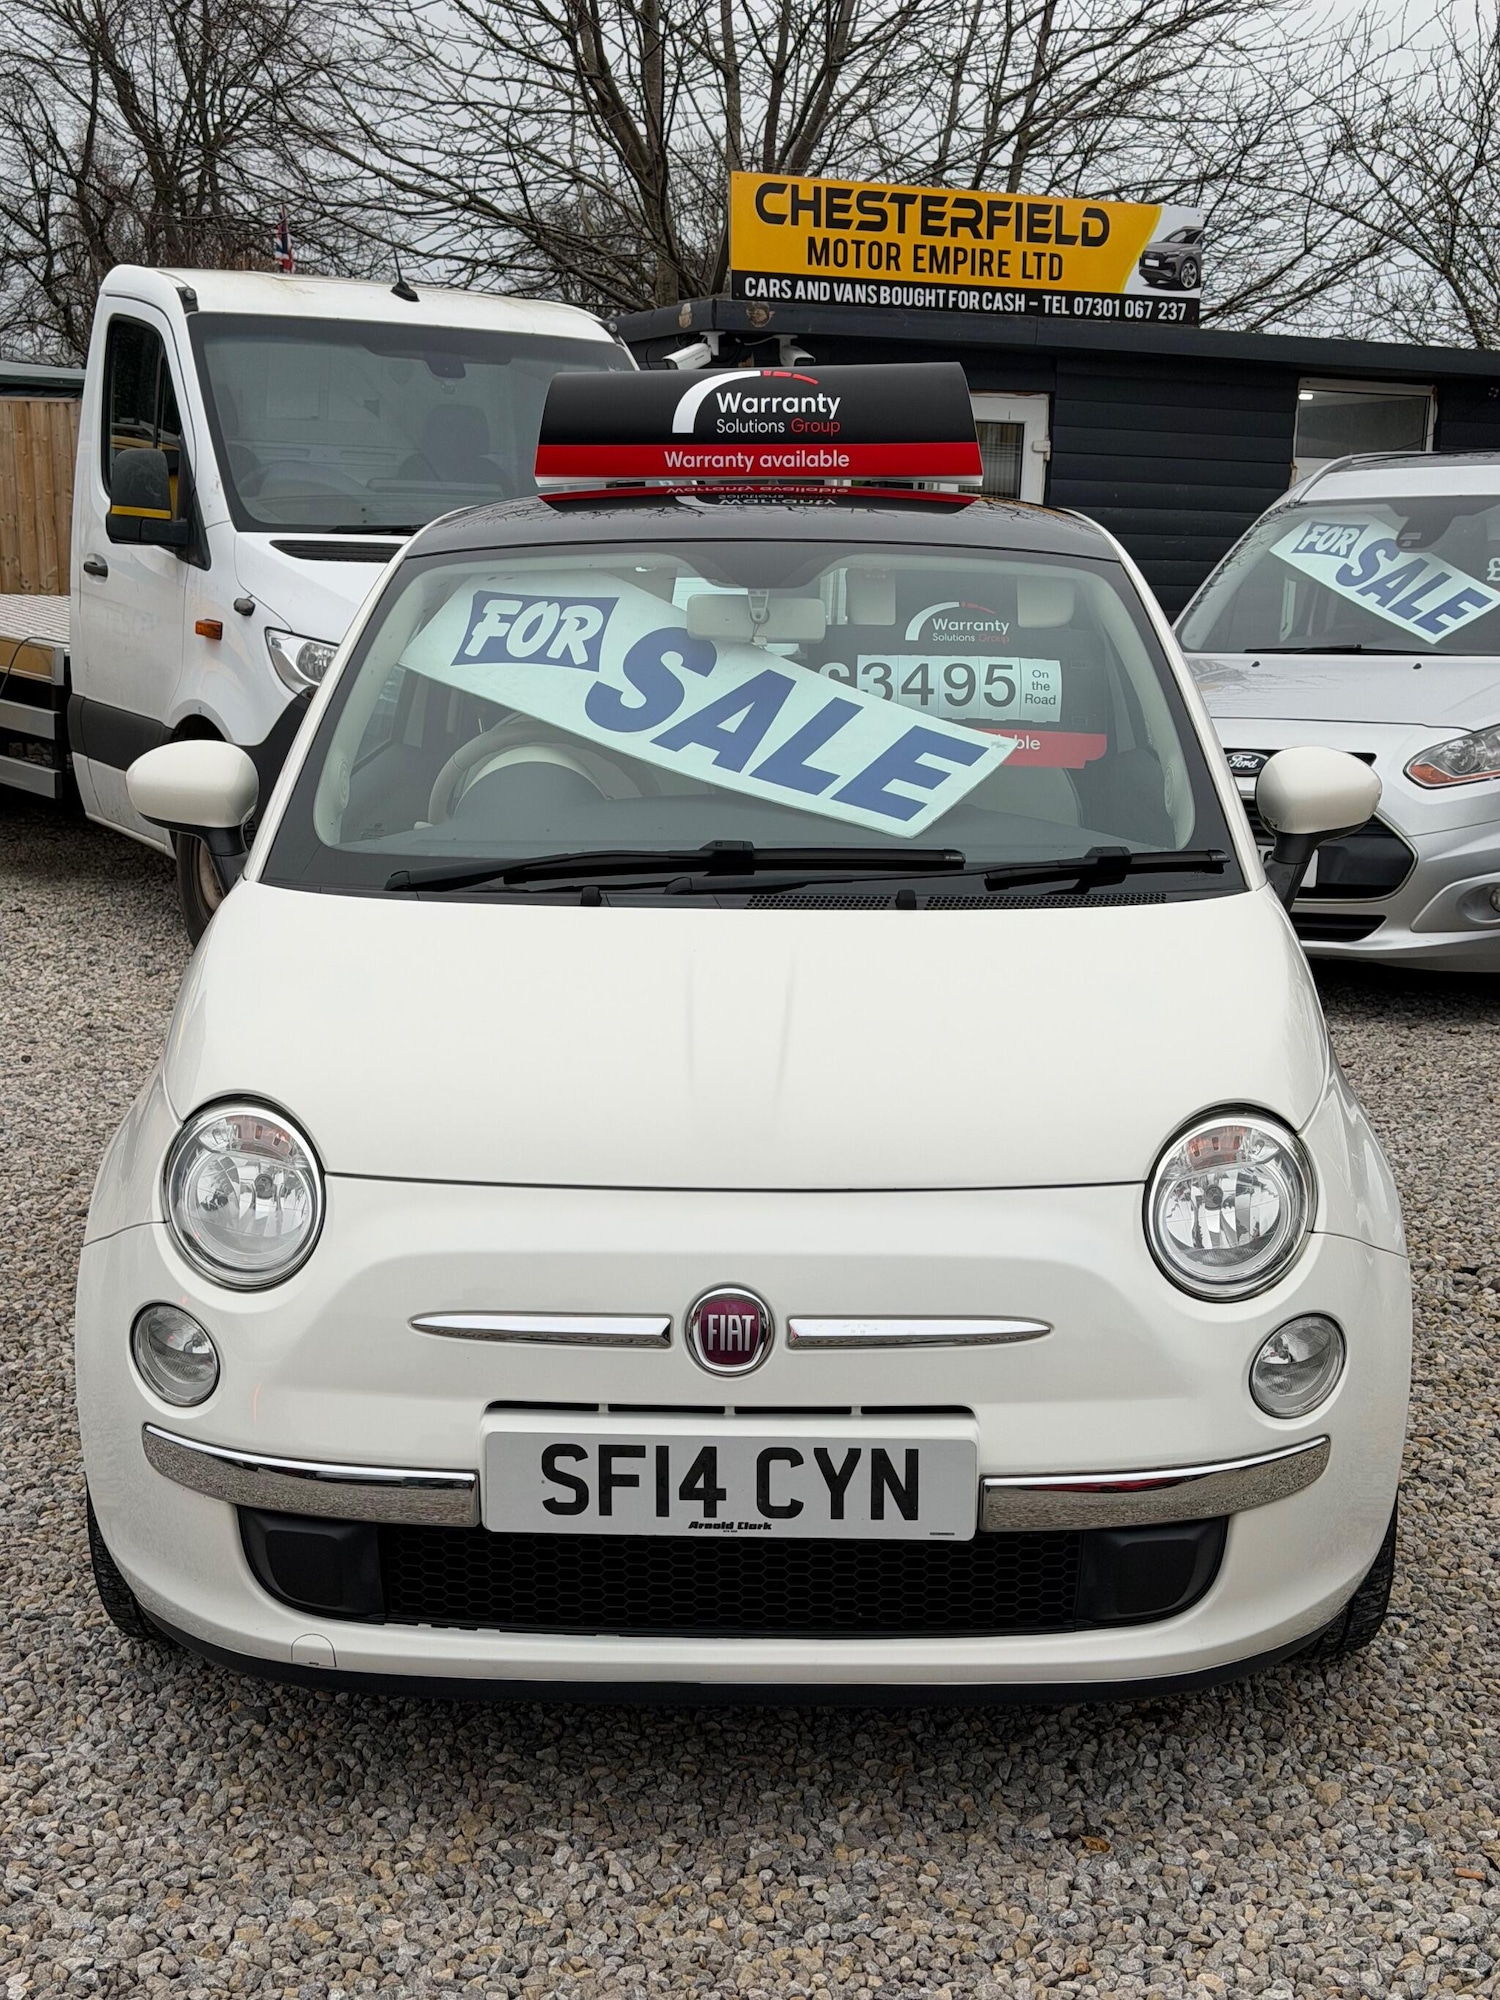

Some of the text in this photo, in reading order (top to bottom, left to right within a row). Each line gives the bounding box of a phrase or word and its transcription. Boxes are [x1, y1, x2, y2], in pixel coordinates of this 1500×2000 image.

[755, 181, 1111, 248] CHESTERFIELD
[807, 236, 1063, 281] MOTOR EMPIRE LTD
[744, 277, 791, 299] CARS
[795, 280, 830, 301] AND
[833, 282, 878, 305] VANS
[880, 284, 944, 309] BOUGHT
[946, 288, 980, 310] FOR
[982, 290, 1026, 313] CASH
[1042, 294, 1070, 316] TEL
[1073, 295, 1120, 318] 07301
[1124, 299, 1154, 319] 067
[1157, 301, 1187, 321] 237
[716, 391, 841, 420] Warranty
[716, 418, 841, 437] Solutions Group
[664, 450, 850, 473] Warranty available
[1298, 525, 1361, 557] FOR
[1335, 538, 1494, 635] SALE
[471, 598, 606, 666] FOR
[932, 617, 1010, 635] Warranty
[932, 632, 976, 643] Solutions
[1031, 669, 1049, 679] On
[1031, 680, 1050, 692] the
[1024, 693, 1056, 706] Road
[585, 626, 989, 822] SALE
[1228, 753, 1258, 769] Ford
[706, 1313, 755, 1352] FIAT
[541, 1443, 919, 1521] SF14 CYN
